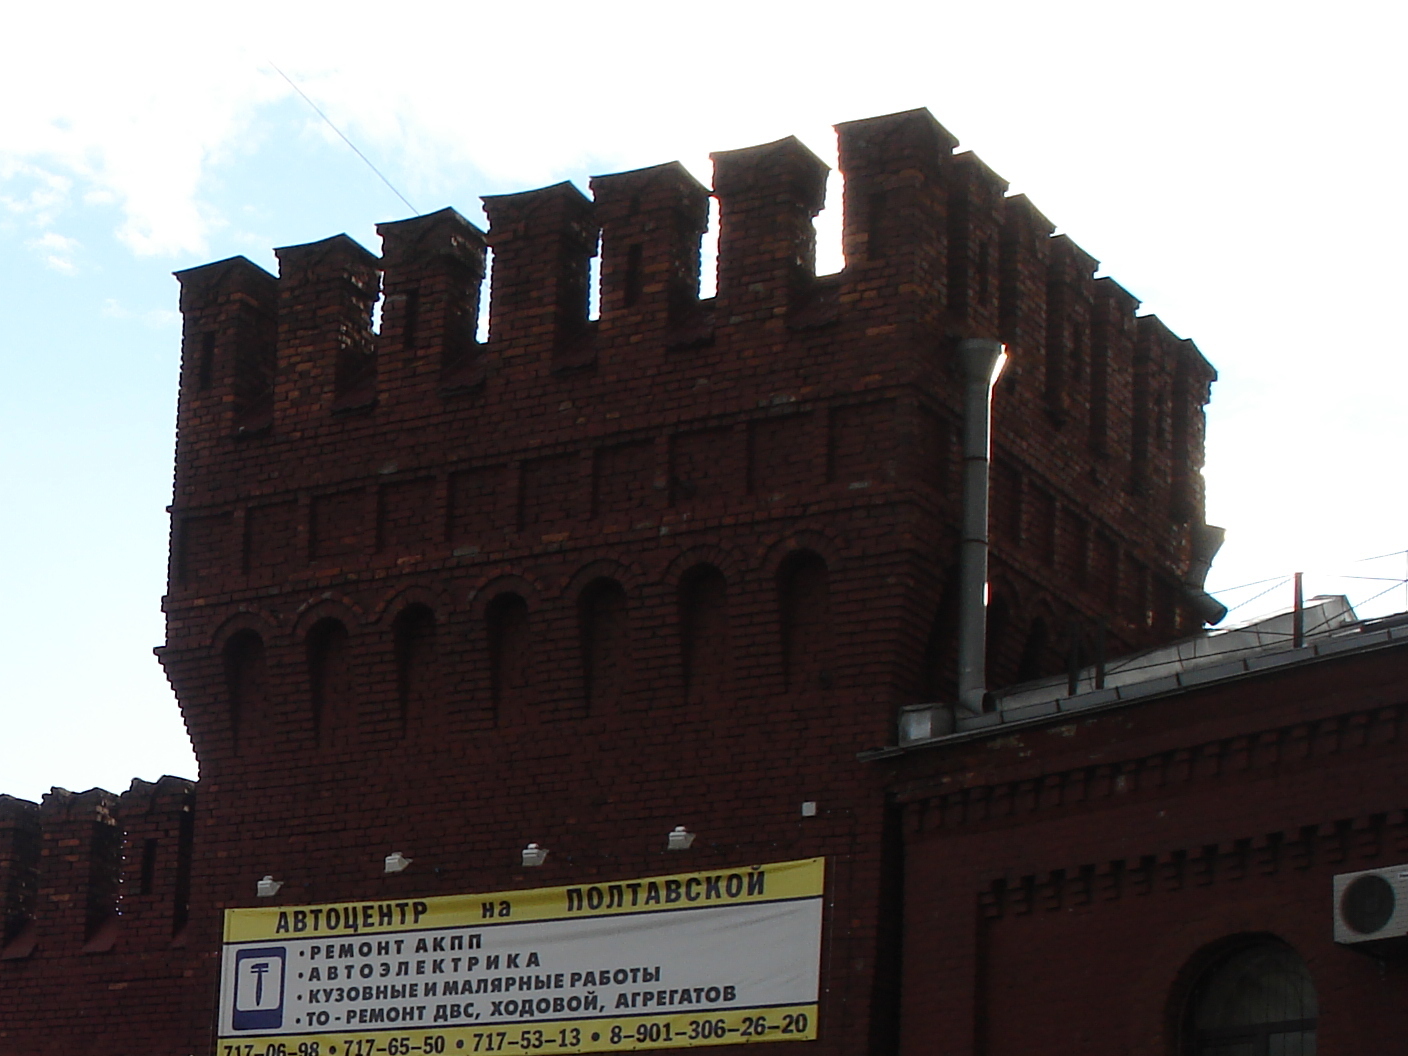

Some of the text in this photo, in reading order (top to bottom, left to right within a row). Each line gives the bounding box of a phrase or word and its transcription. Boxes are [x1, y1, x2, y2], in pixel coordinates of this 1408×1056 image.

[276, 866, 765, 934] АВТОЦЕНТР на ПОЛТАВСКОЙ
[310, 934, 483, 960] РЕМОНТ АКПП
[308, 952, 541, 982] АВТОЭЛЕКТРИКА
[308, 966, 660, 1004] КУЗОВНЫЕ И МАЛЯРНЫЕ РАБОТЫ
[306, 985, 736, 1027] ТО РЕМОНТ ДВС, ХОДОВОЙ, АГРЕГАТОВ
[472, 1027, 581, 1053] 717-53-13
[609, 1014, 808, 1045] 8-901-306-26-20
